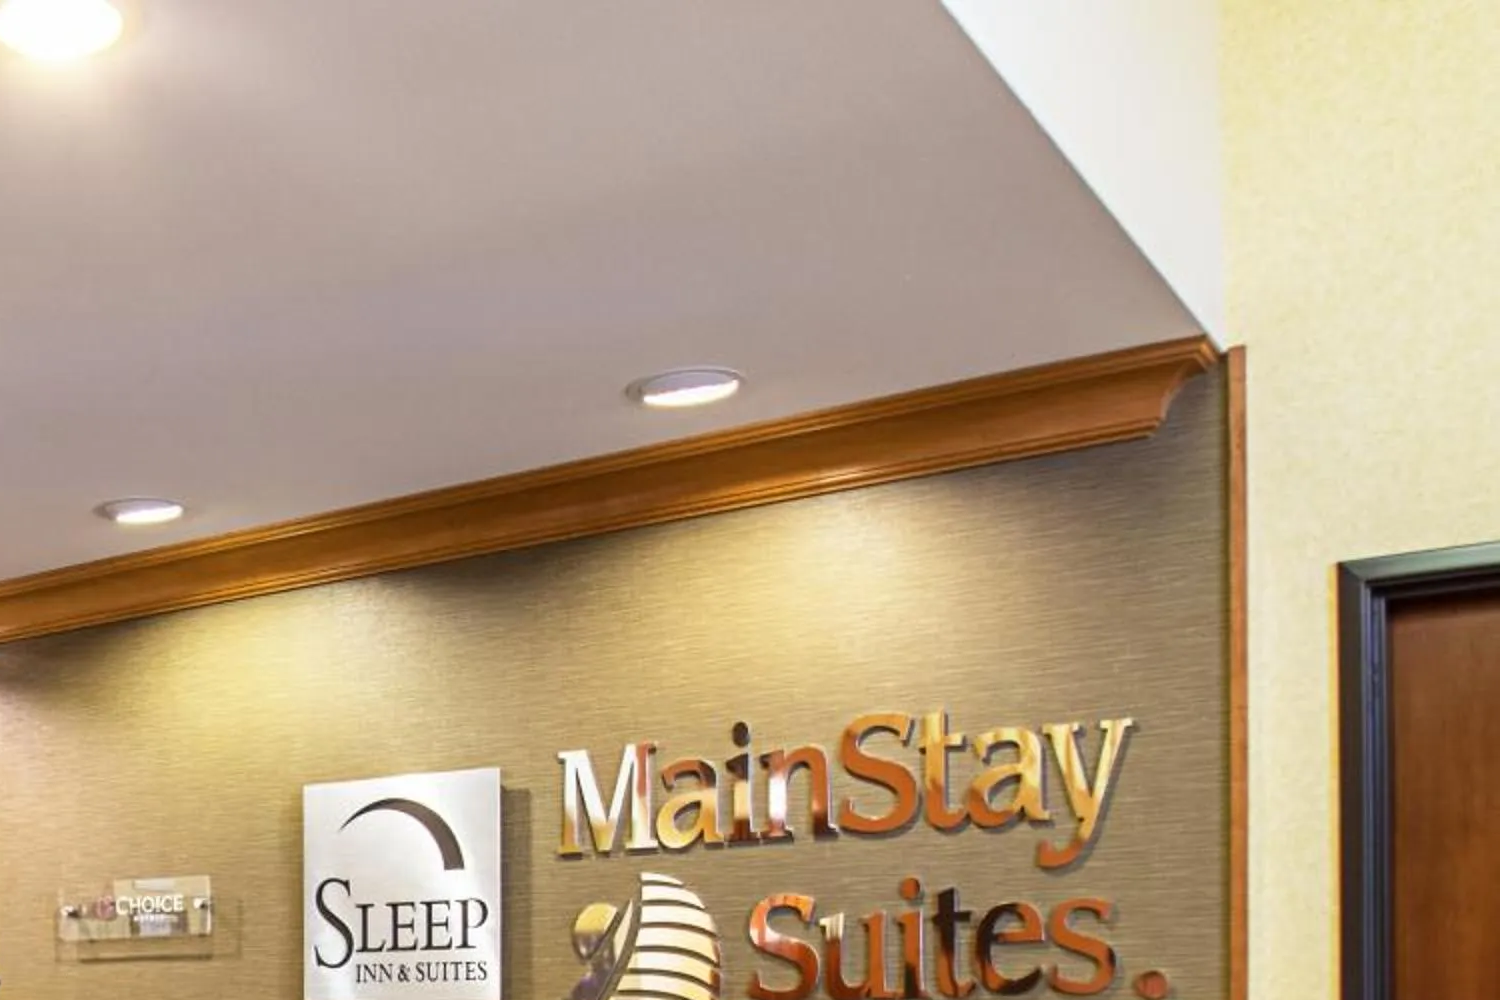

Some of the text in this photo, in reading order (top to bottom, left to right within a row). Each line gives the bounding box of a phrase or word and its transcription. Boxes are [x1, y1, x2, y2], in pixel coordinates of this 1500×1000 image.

[556, 709, 1134, 869] MainStay
[116, 894, 184, 916] CHOICE
[314, 877, 489, 969] SLEEP
[355, 961, 488, 984] INN & SUITES
